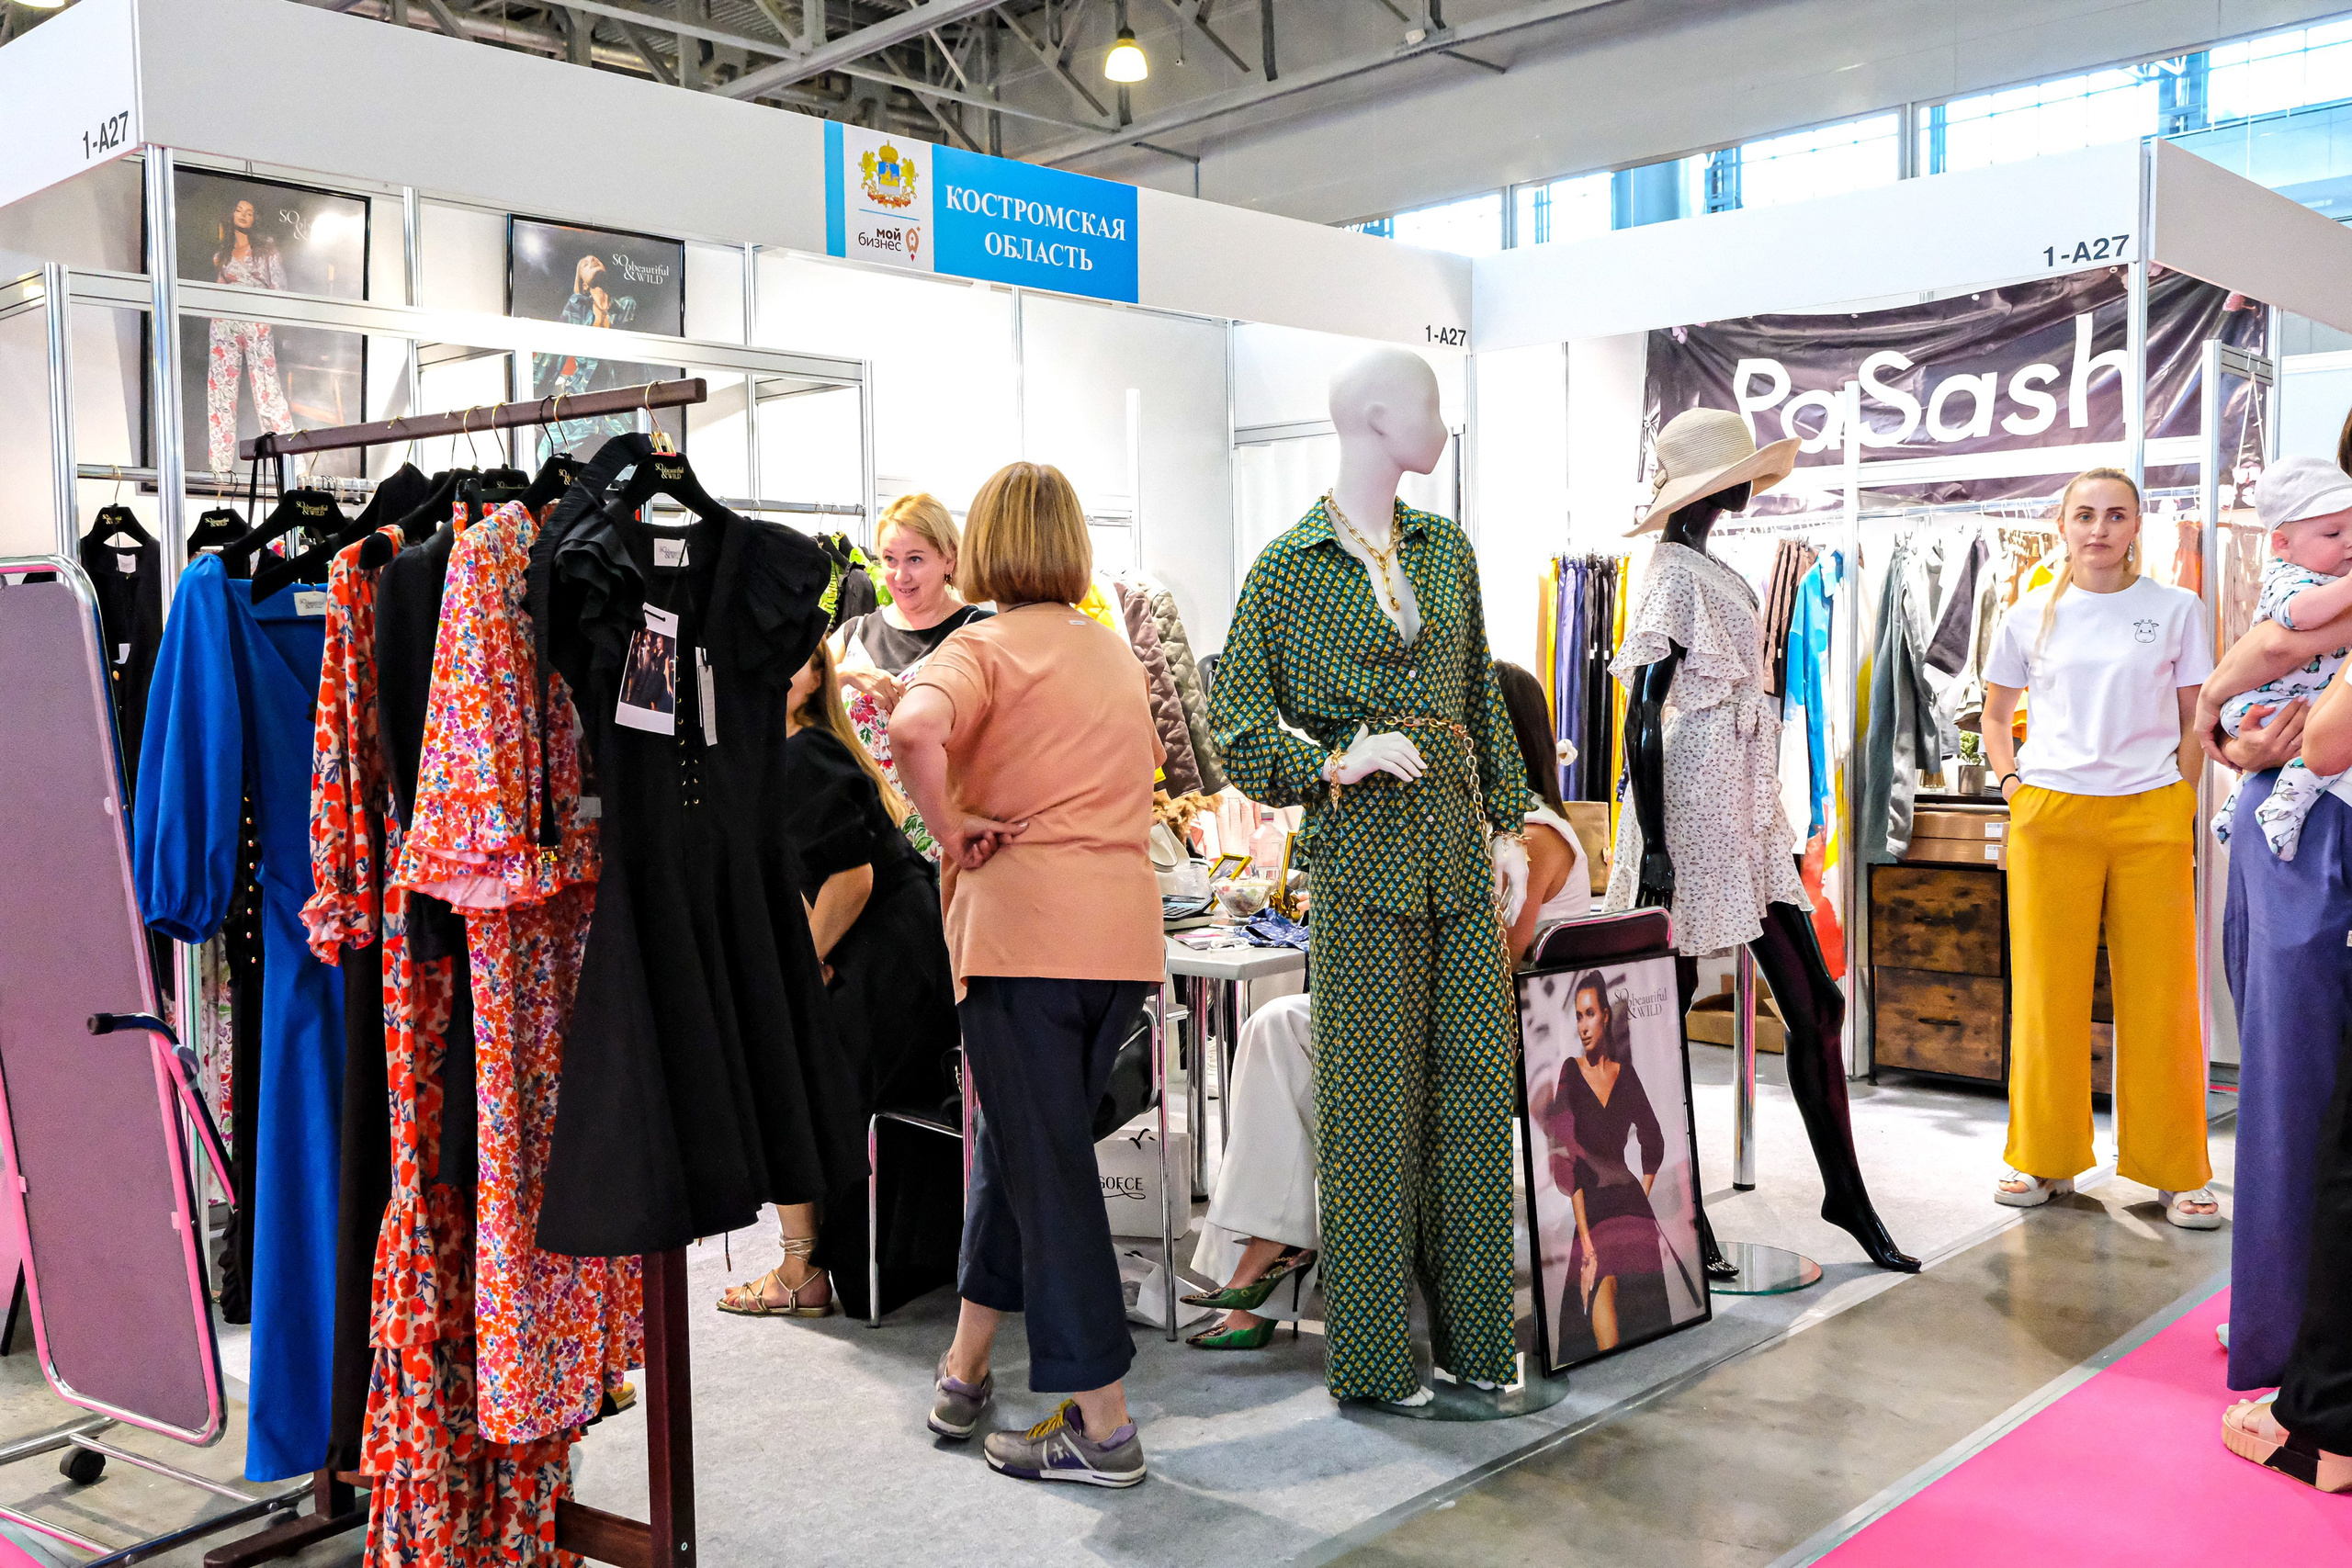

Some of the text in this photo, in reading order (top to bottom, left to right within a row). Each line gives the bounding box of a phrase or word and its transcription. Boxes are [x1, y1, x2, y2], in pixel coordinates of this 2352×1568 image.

[83, 110, 129, 160] 1-A27
[945, 185, 1126, 241] КОСТРОМСКАЯ
[858, 231, 902, 252] бизнес
[984, 231, 1093, 271] ОБЛАСТЬ
[2042, 234, 2130, 267] 1-A27
[1425, 324, 1466, 347] 1-A27
[1733, 313, 2129, 454] PaSash
